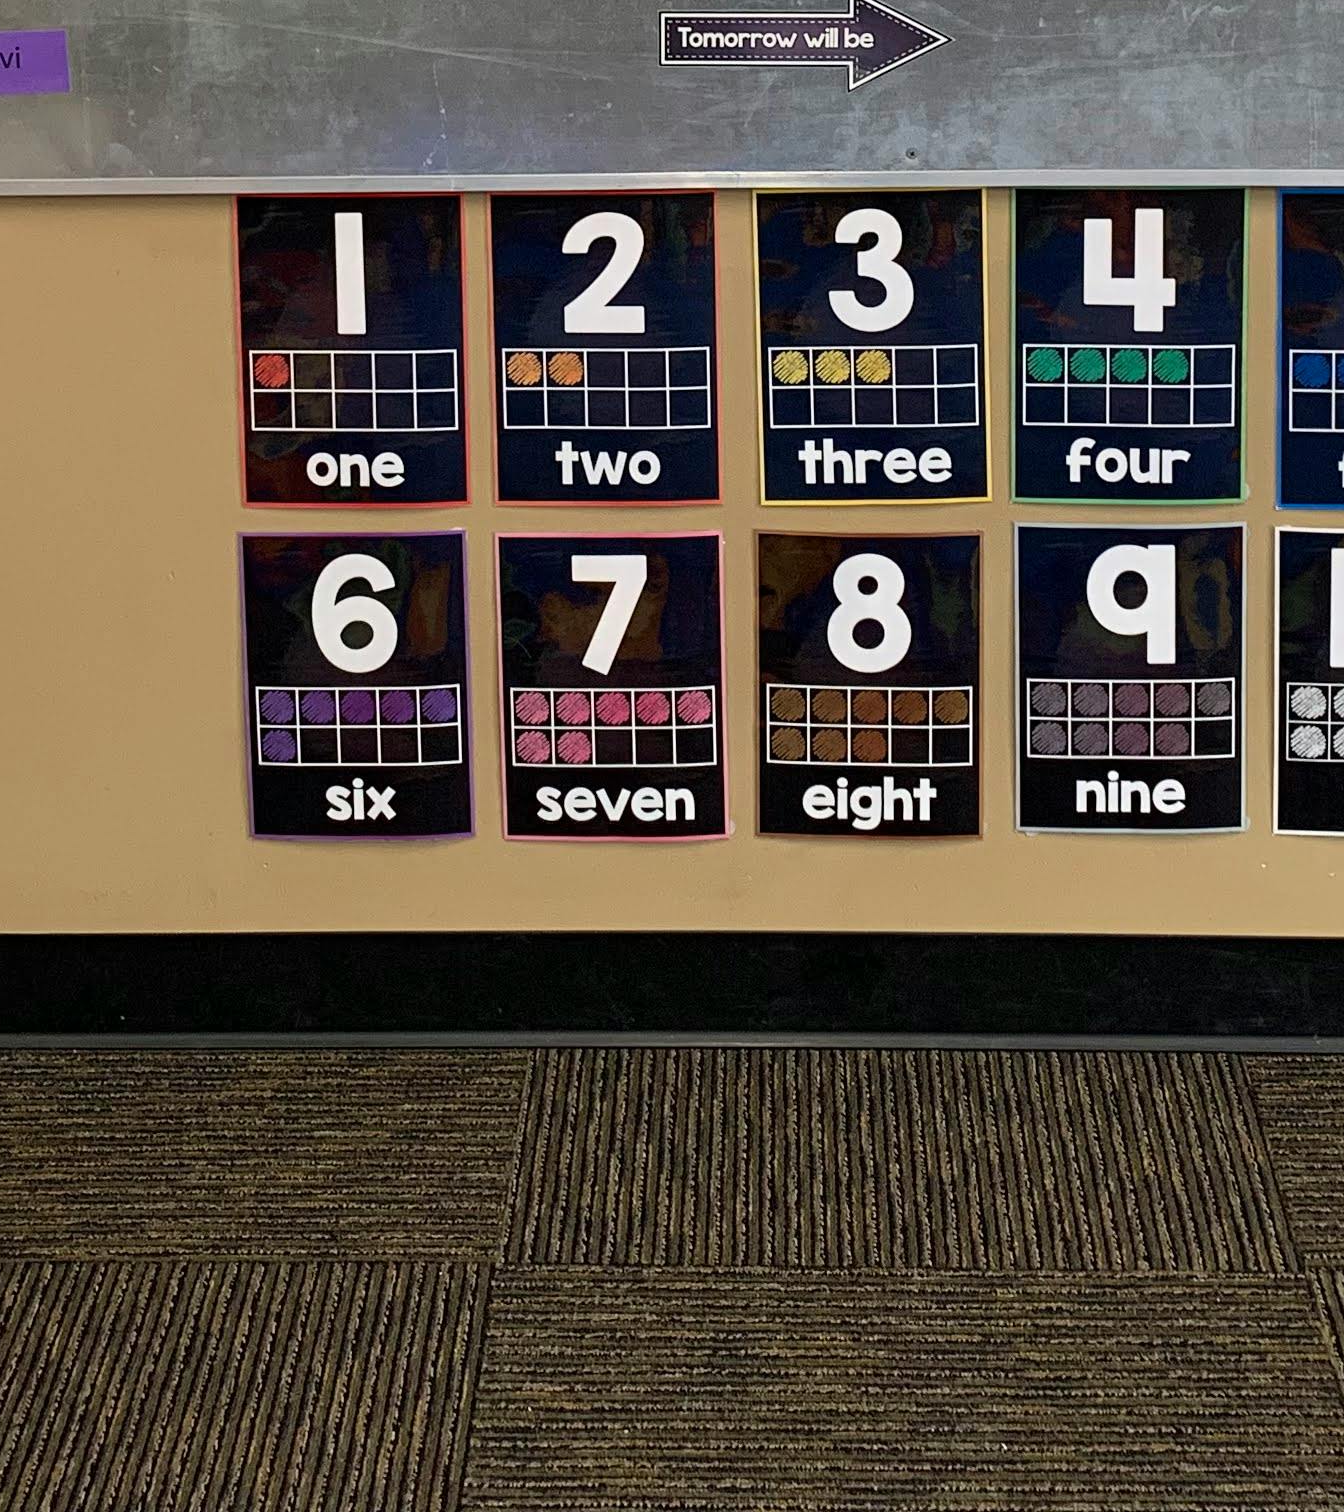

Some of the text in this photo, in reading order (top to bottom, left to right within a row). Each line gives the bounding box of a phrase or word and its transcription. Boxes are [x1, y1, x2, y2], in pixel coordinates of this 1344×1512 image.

[677, 27, 874, 48] Tomorrow will be
[334, 212, 366, 335] 1
[562, 212, 645, 334] 2
[828, 208, 914, 332] 3
[1083, 208, 1176, 332] 4
[306, 451, 405, 487] one
[555, 441, 661, 485] two
[798, 438, 952, 484] three
[1065, 437, 1191, 484] four
[311, 553, 398, 674] 6
[571, 554, 648, 676] 7
[827, 553, 912, 673] 8
[1086, 544, 1176, 664] 9
[326, 777, 396, 822] six
[536, 785, 696, 822] seven
[802, 777, 937, 830] eight
[1075, 770, 1186, 815] nine
